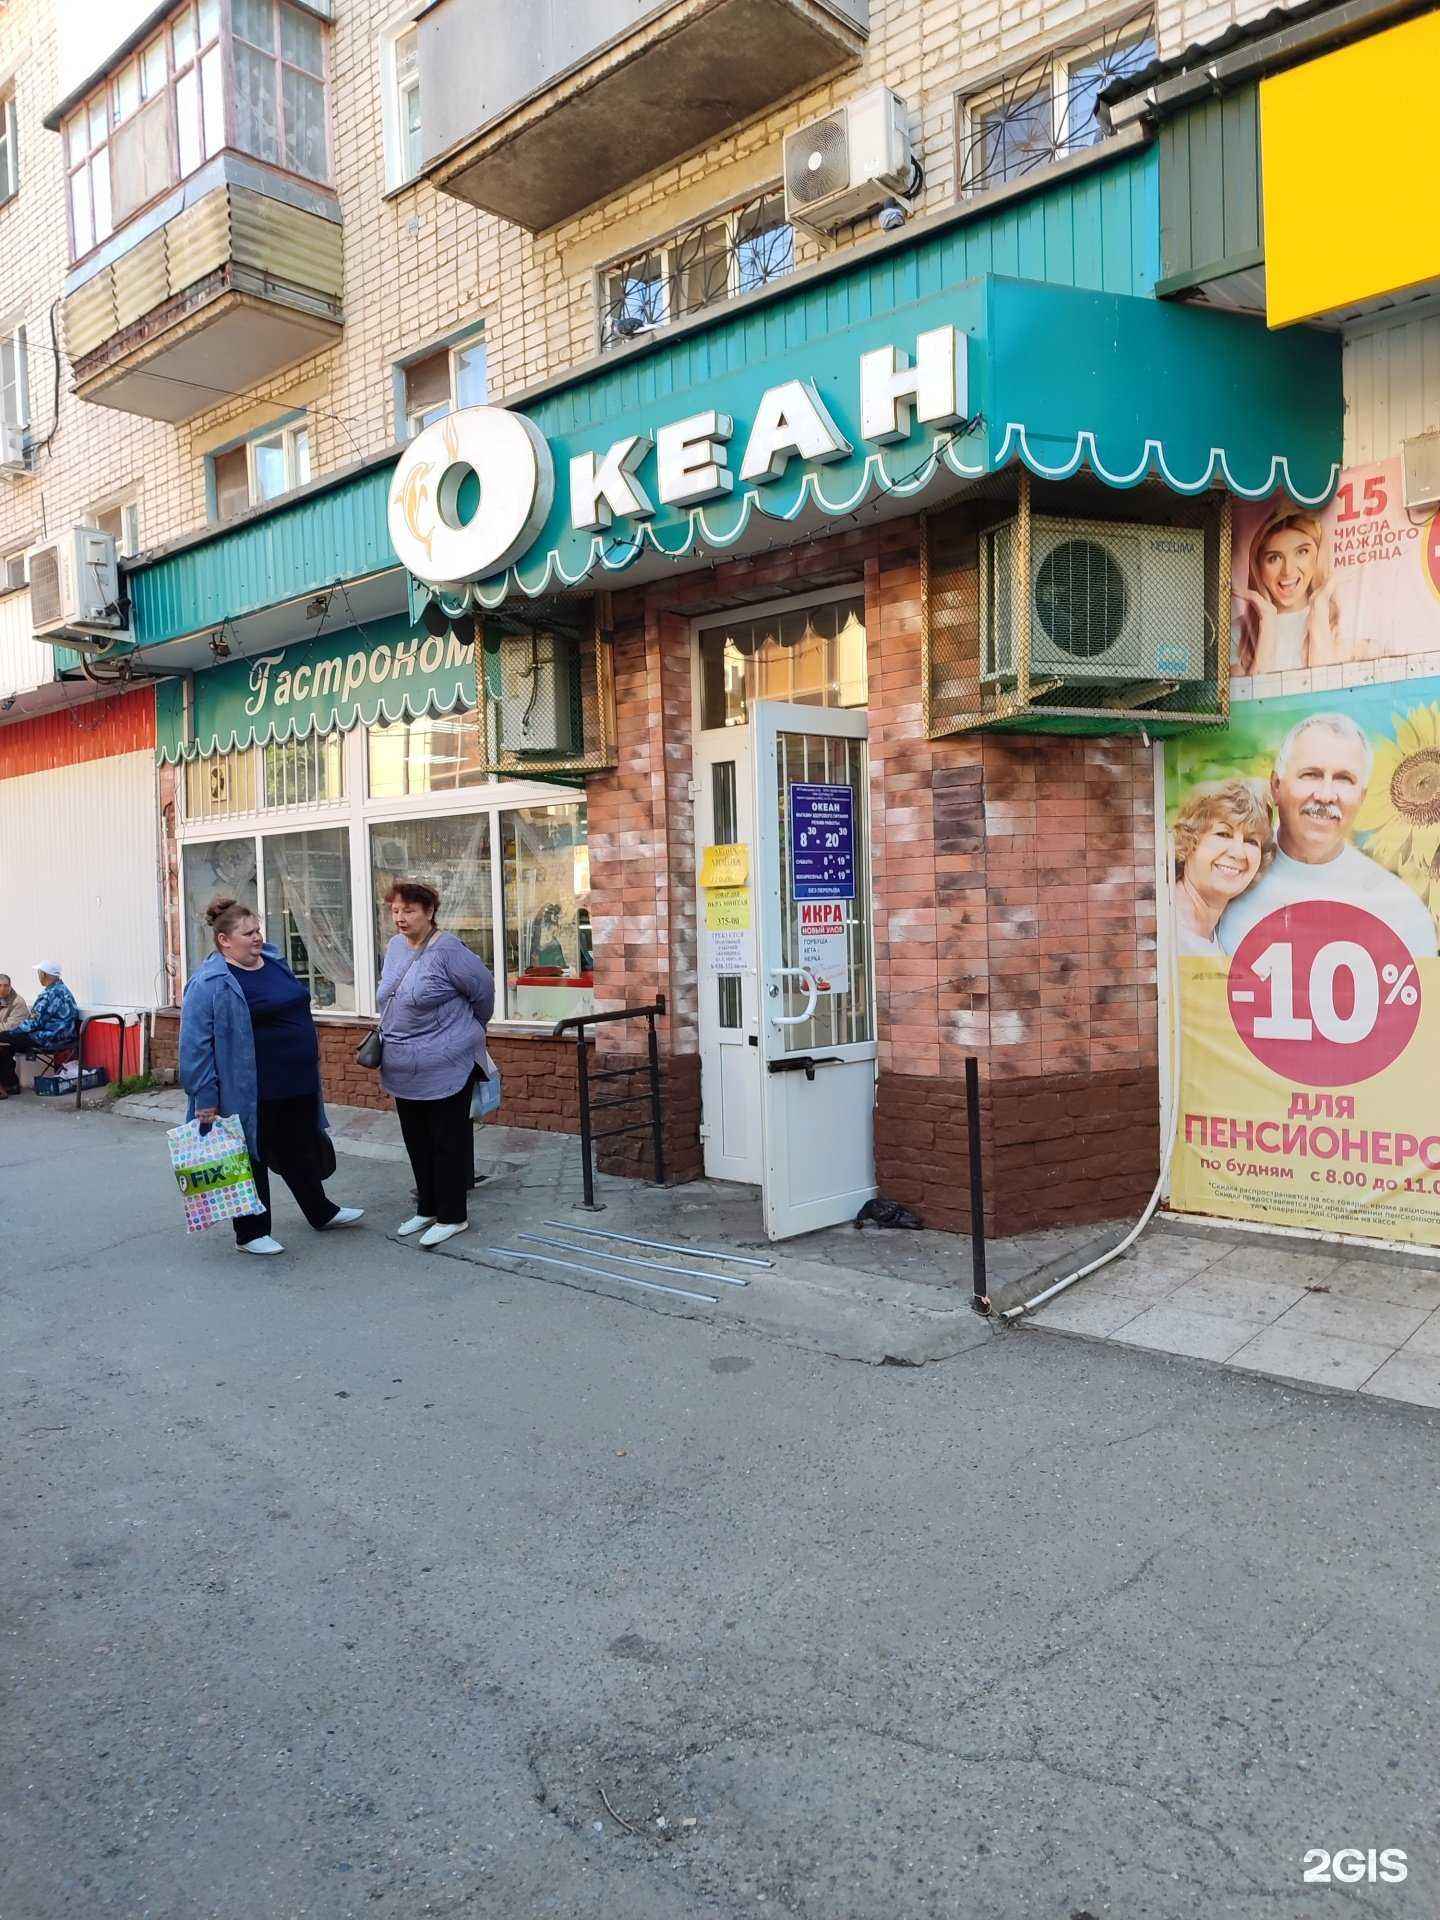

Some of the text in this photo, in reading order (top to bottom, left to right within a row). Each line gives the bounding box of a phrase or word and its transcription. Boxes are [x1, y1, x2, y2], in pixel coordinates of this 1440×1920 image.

[387, 324, 969, 583] ОКЕАН
[1335, 475, 1388, 523] 15
[1333, 519, 1391, 539] ЧИСЛА
[1333, 527, 1420, 553] КАЖДОГО
[1333, 545, 1402, 568] МЕСЯЦА
[245, 630, 476, 716] Гастроном
[811, 802, 840, 812] ОКЕАН
[802, 904, 843, 923] ИКРА
[1232, 940, 1419, 1044] -10%
[1287, 1091, 1356, 1121] ДЛЯ
[191, 1164, 227, 1188] FIX
[1200, 1158, 1222, 1171] по
[1226, 1158, 1294, 1179] будням
[1310, 1171, 1321, 1182] с
[1325, 1169, 1368, 1188] 8.00
[1372, 1177, 1398, 1192] до
